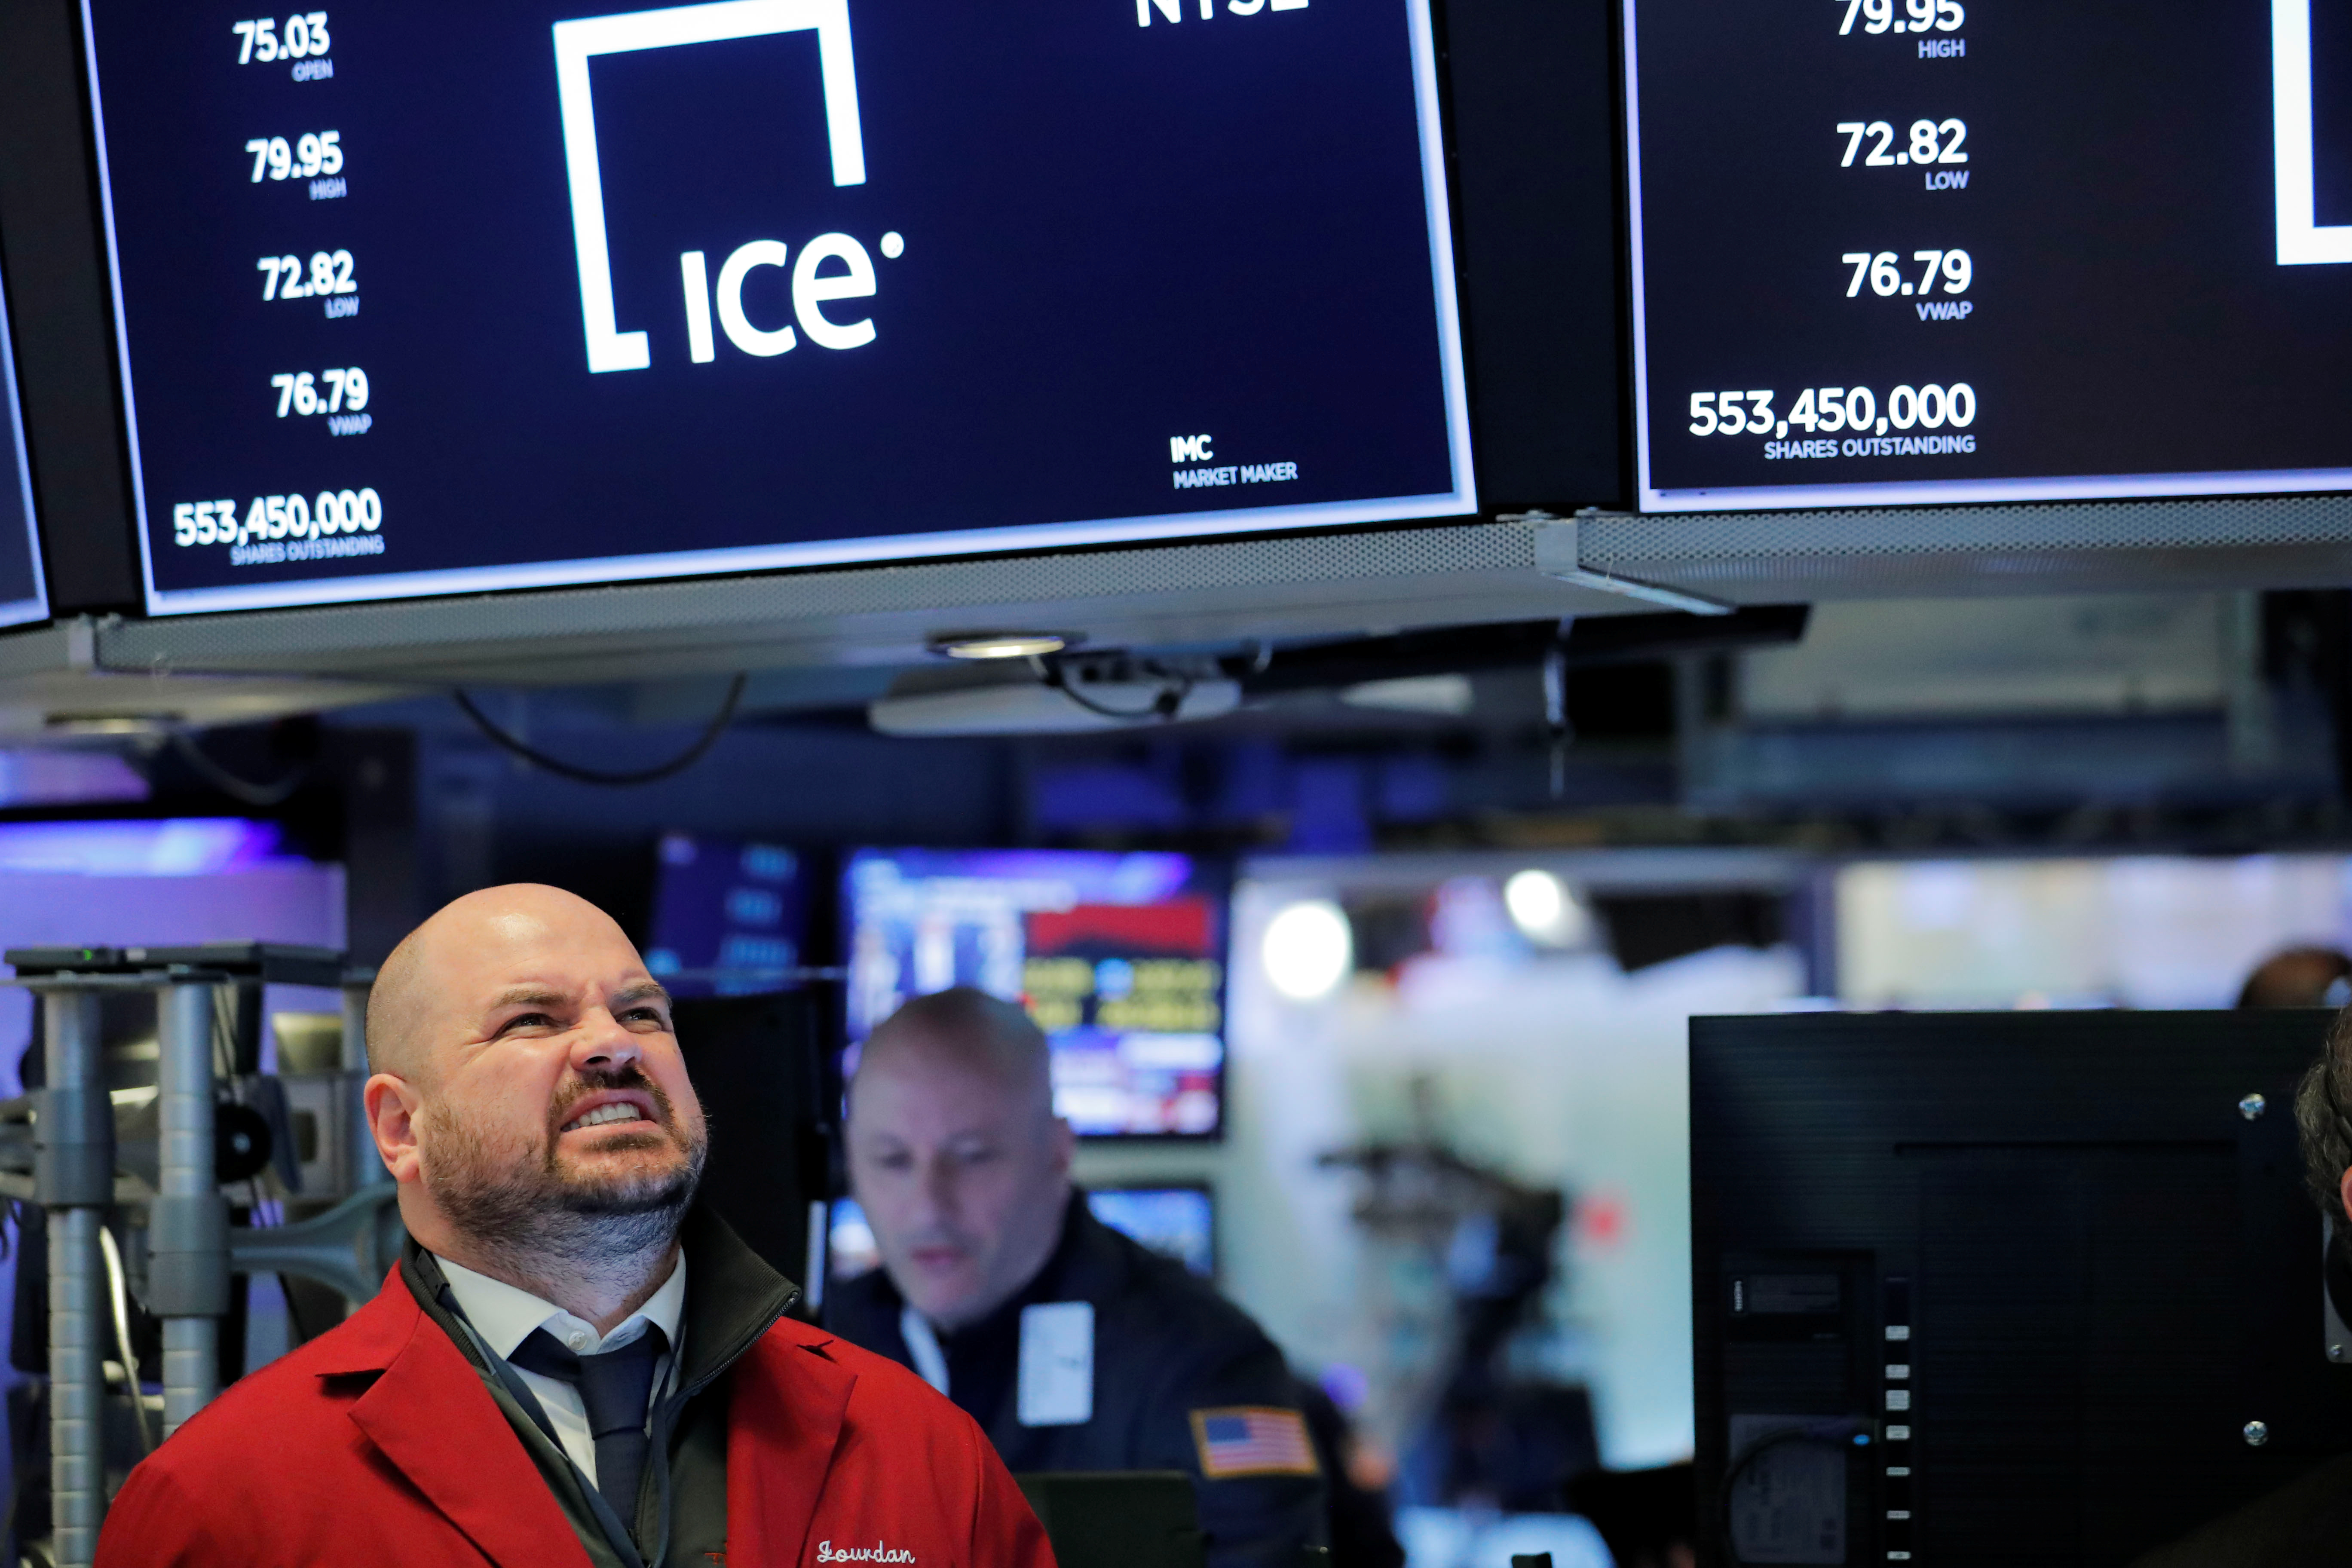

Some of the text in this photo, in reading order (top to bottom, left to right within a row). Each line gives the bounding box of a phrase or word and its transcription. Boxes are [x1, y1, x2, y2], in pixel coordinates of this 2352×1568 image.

[1835, 0, 1965, 36] 79.95
[232, 11, 331, 64] 75.03
[1918, 39, 1965, 59] HIGH
[291, 58, 334, 82] OPEN
[245, 130, 343, 184] 79.95
[1836, 118, 1968, 167] 72.82
[309, 177, 347, 201] HIGH
[1925, 170, 1969, 190] LOW
[257, 249, 357, 302] 72.82
[1842, 248, 1972, 298] 76.79
[324, 296, 359, 319] LOW
[1915, 301, 1973, 321] VWAP
[270, 366, 369, 419] 76.79
[327, 413, 372, 437] VWAP
[1689, 383, 1976, 439] 553,450,000
[1170, 434, 1214, 463] IMC
[1764, 435, 1976, 460] SHARES OUTSTANDING
[1173, 462, 1298, 489] MARKET MAKER
[174, 488, 383, 547] 553,450,000
[230, 534, 385, 566] SHARES OUTSTANDING
